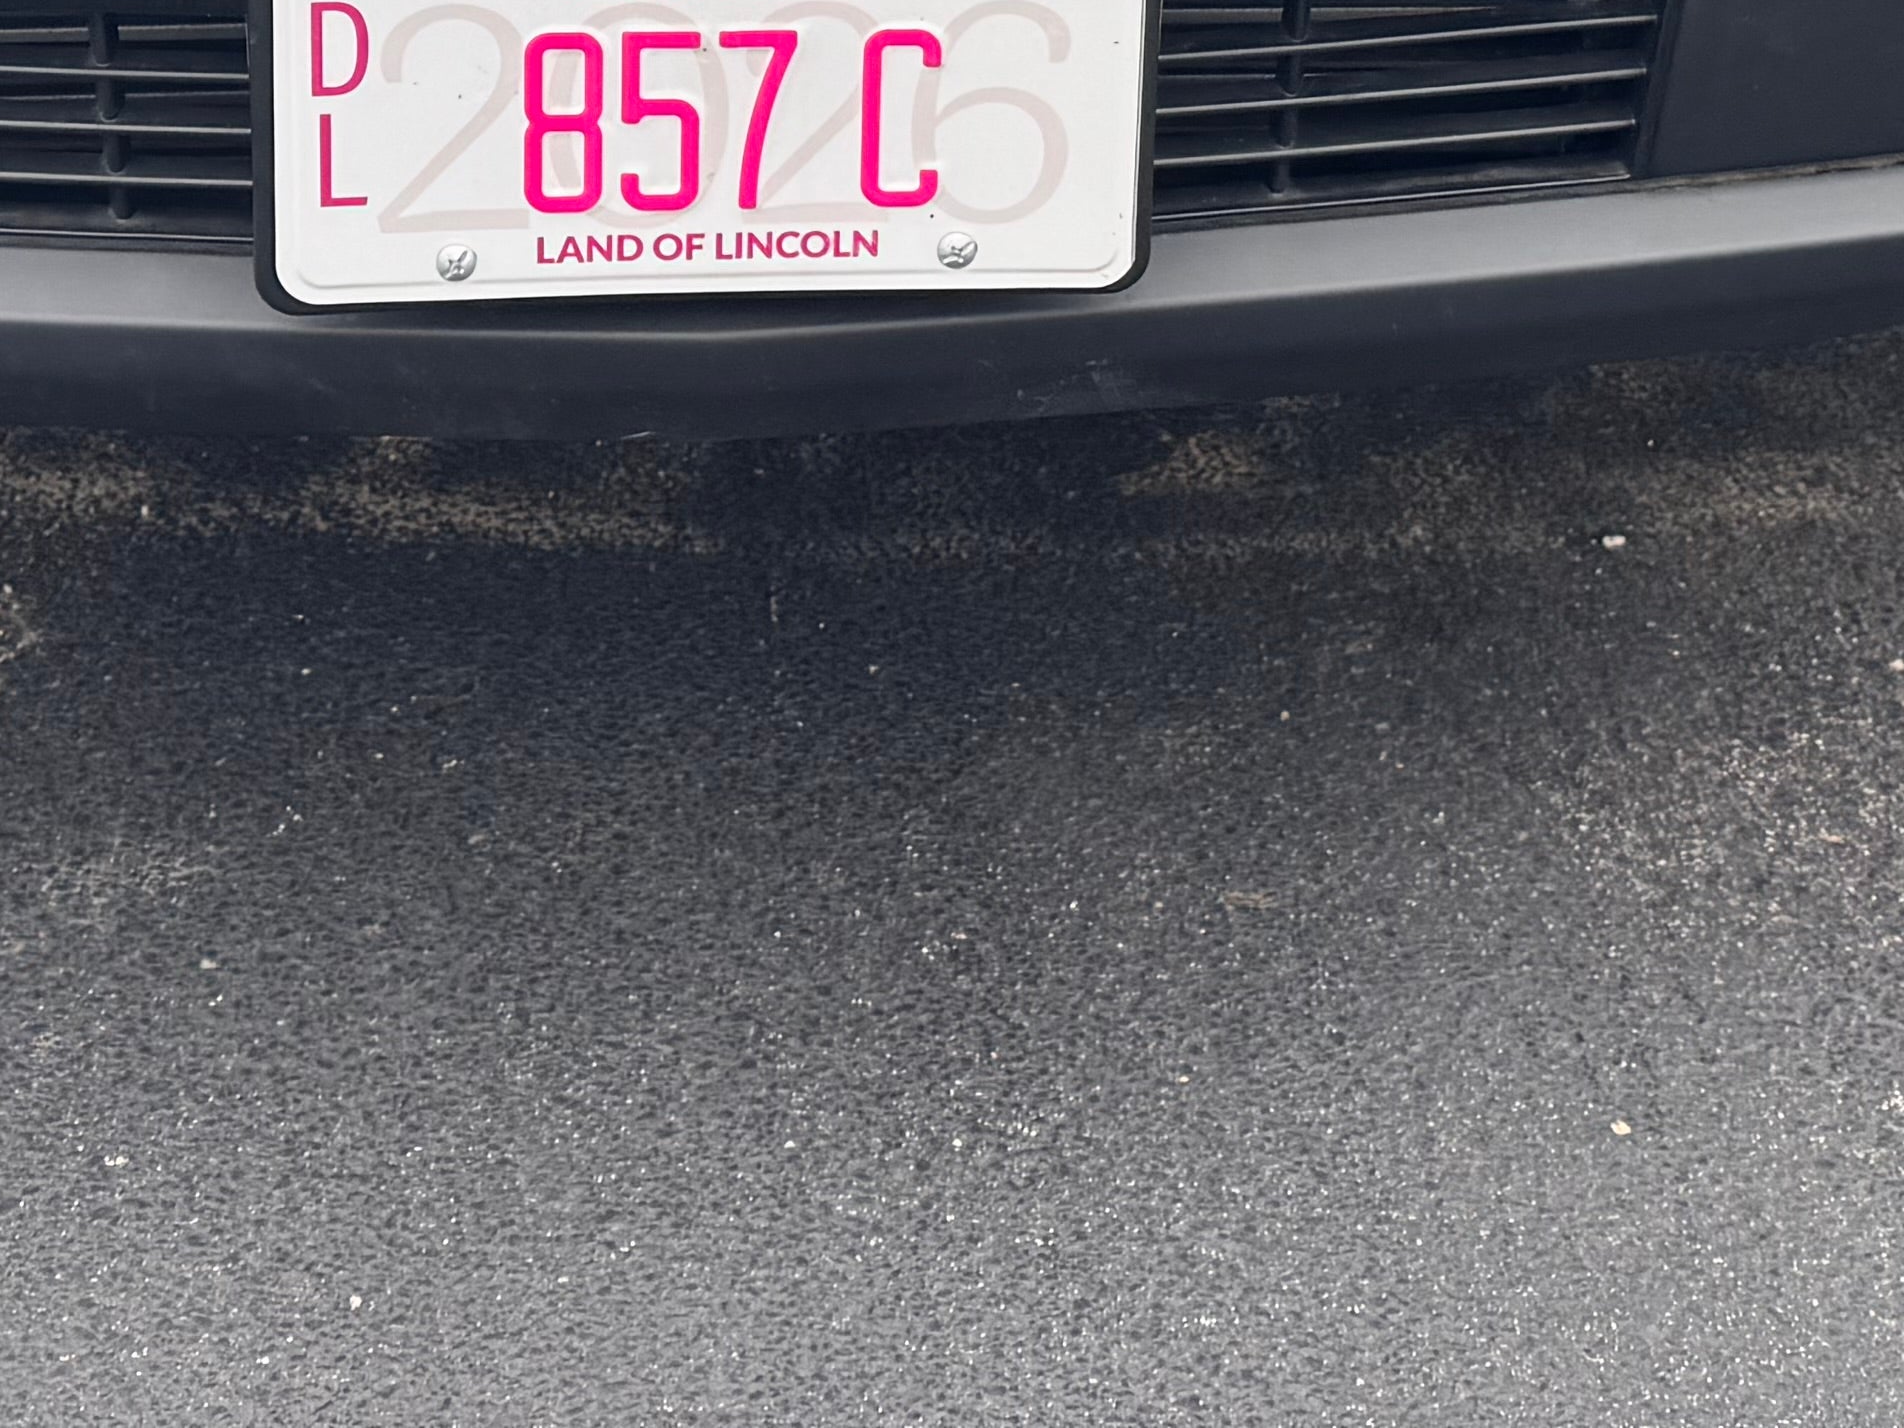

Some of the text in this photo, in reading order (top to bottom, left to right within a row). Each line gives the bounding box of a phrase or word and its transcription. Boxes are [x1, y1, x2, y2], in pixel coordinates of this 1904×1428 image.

[523, 28, 944, 214] 857 C
[537, 231, 880, 265] LAND OF LINCOLN
